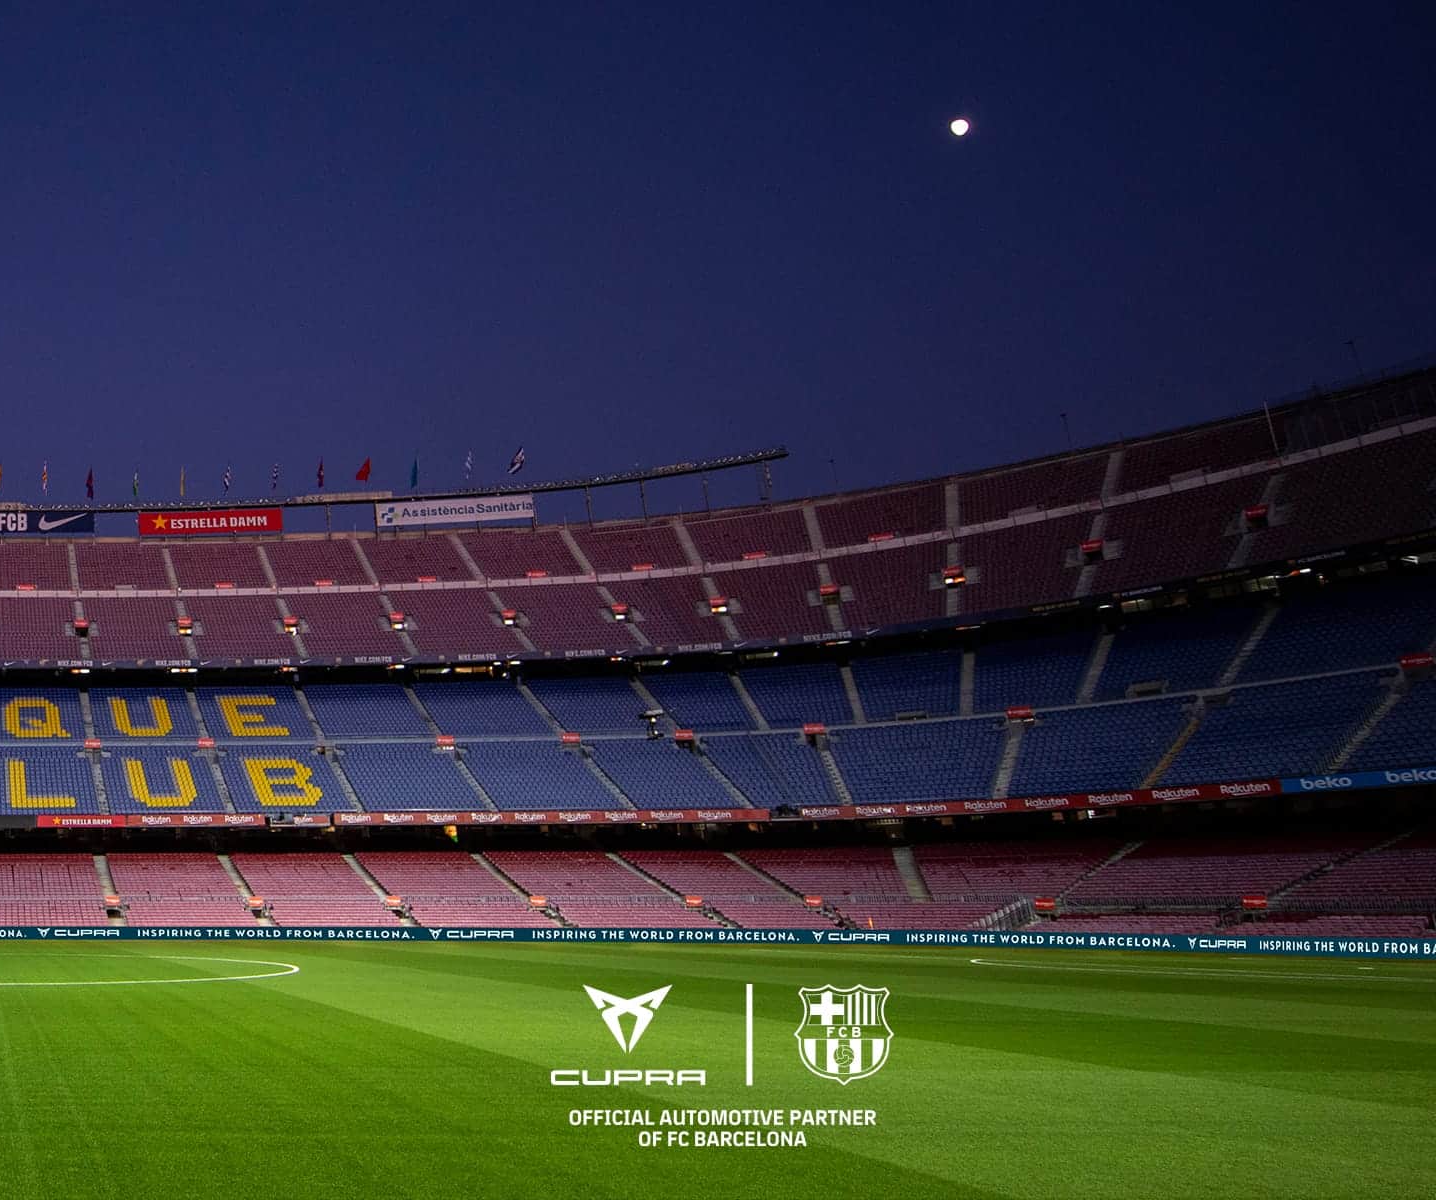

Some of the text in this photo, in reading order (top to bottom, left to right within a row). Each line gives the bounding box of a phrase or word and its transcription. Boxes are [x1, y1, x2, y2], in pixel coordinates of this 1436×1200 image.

[401, 501, 532, 519] Assistència Sanitària
[170, 515, 268, 529] ESTRELLA DAMM
[4, 695, 290, 739] QUE
[1300, 775, 1352, 790] beko
[1152, 786, 1199, 800] Rakuten
[1220, 782, 1270, 795] Rakuten
[1025, 796, 1068, 809] Rakuten
[1088, 792, 1132, 805] Rakuten
[905, 801, 947, 814] Rakuten
[964, 800, 1007, 811] Rakuten
[472, 812, 502, 821] Rakuten
[515, 812, 546, 821] Rakuten
[559, 812, 591, 821] Rakuten
[605, 811, 636, 820] Rakuten
[651, 810, 683, 820] Rakuten
[698, 810, 731, 820] Rakuten
[802, 807, 840, 817] Rakuten
[142, 815, 171, 824] Rakuten
[183, 815, 212, 824] Rakuten
[224, 815, 254, 824] Rakuten
[341, 814, 371, 823] Rakuten
[384, 813, 414, 822] Rakuten
[426, 813, 457, 822] Rakuten
[328, 930, 415, 938] BARCELONA.
[532, 930, 800, 940] INSPIRING THE WORLD FROM BARCELONA.
[828, 933, 889, 941] CUPRA
[907, 934, 1175, 947] INSPIRING THE WORLD FROM BARCELONA.
[1200, 940, 1246, 948] CUPRA
[1260, 941, 1310, 951] INSPIRING
[1314, 942, 1334, 951] THE
[1339, 942, 1379, 952] WORLD
[1384, 943, 1418, 953] FROM
